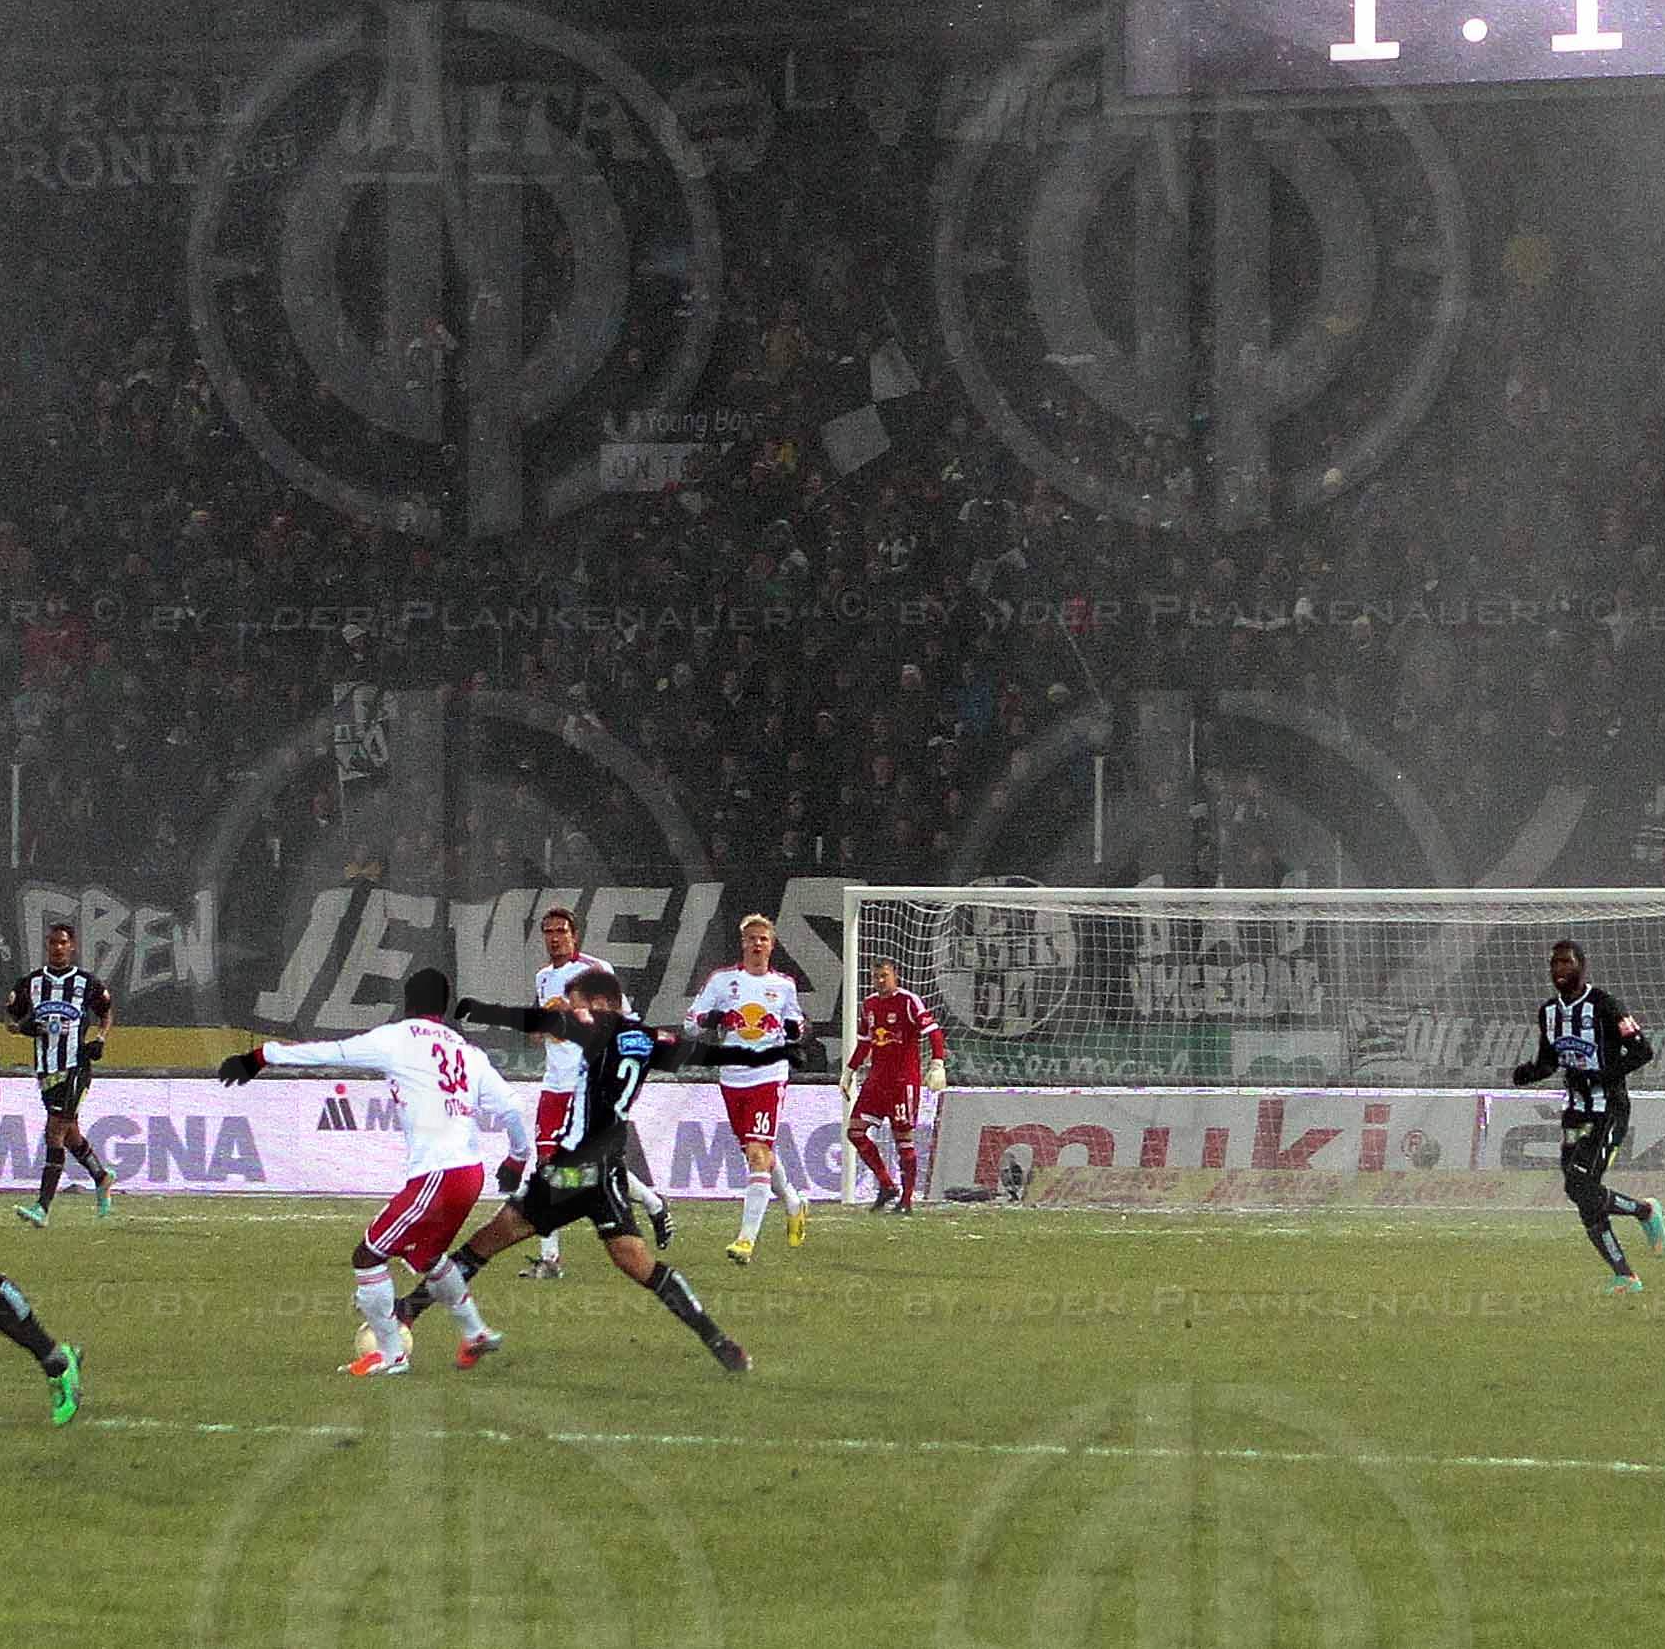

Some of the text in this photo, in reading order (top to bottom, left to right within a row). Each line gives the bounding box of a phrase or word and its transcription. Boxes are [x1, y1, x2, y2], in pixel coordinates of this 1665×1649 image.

[252, 878, 870, 1032] JEWELS
[431, 1042, 469, 1095] 34
[754, 1111, 770, 1134] 36
[974, 1098, 1391, 1192] muki
